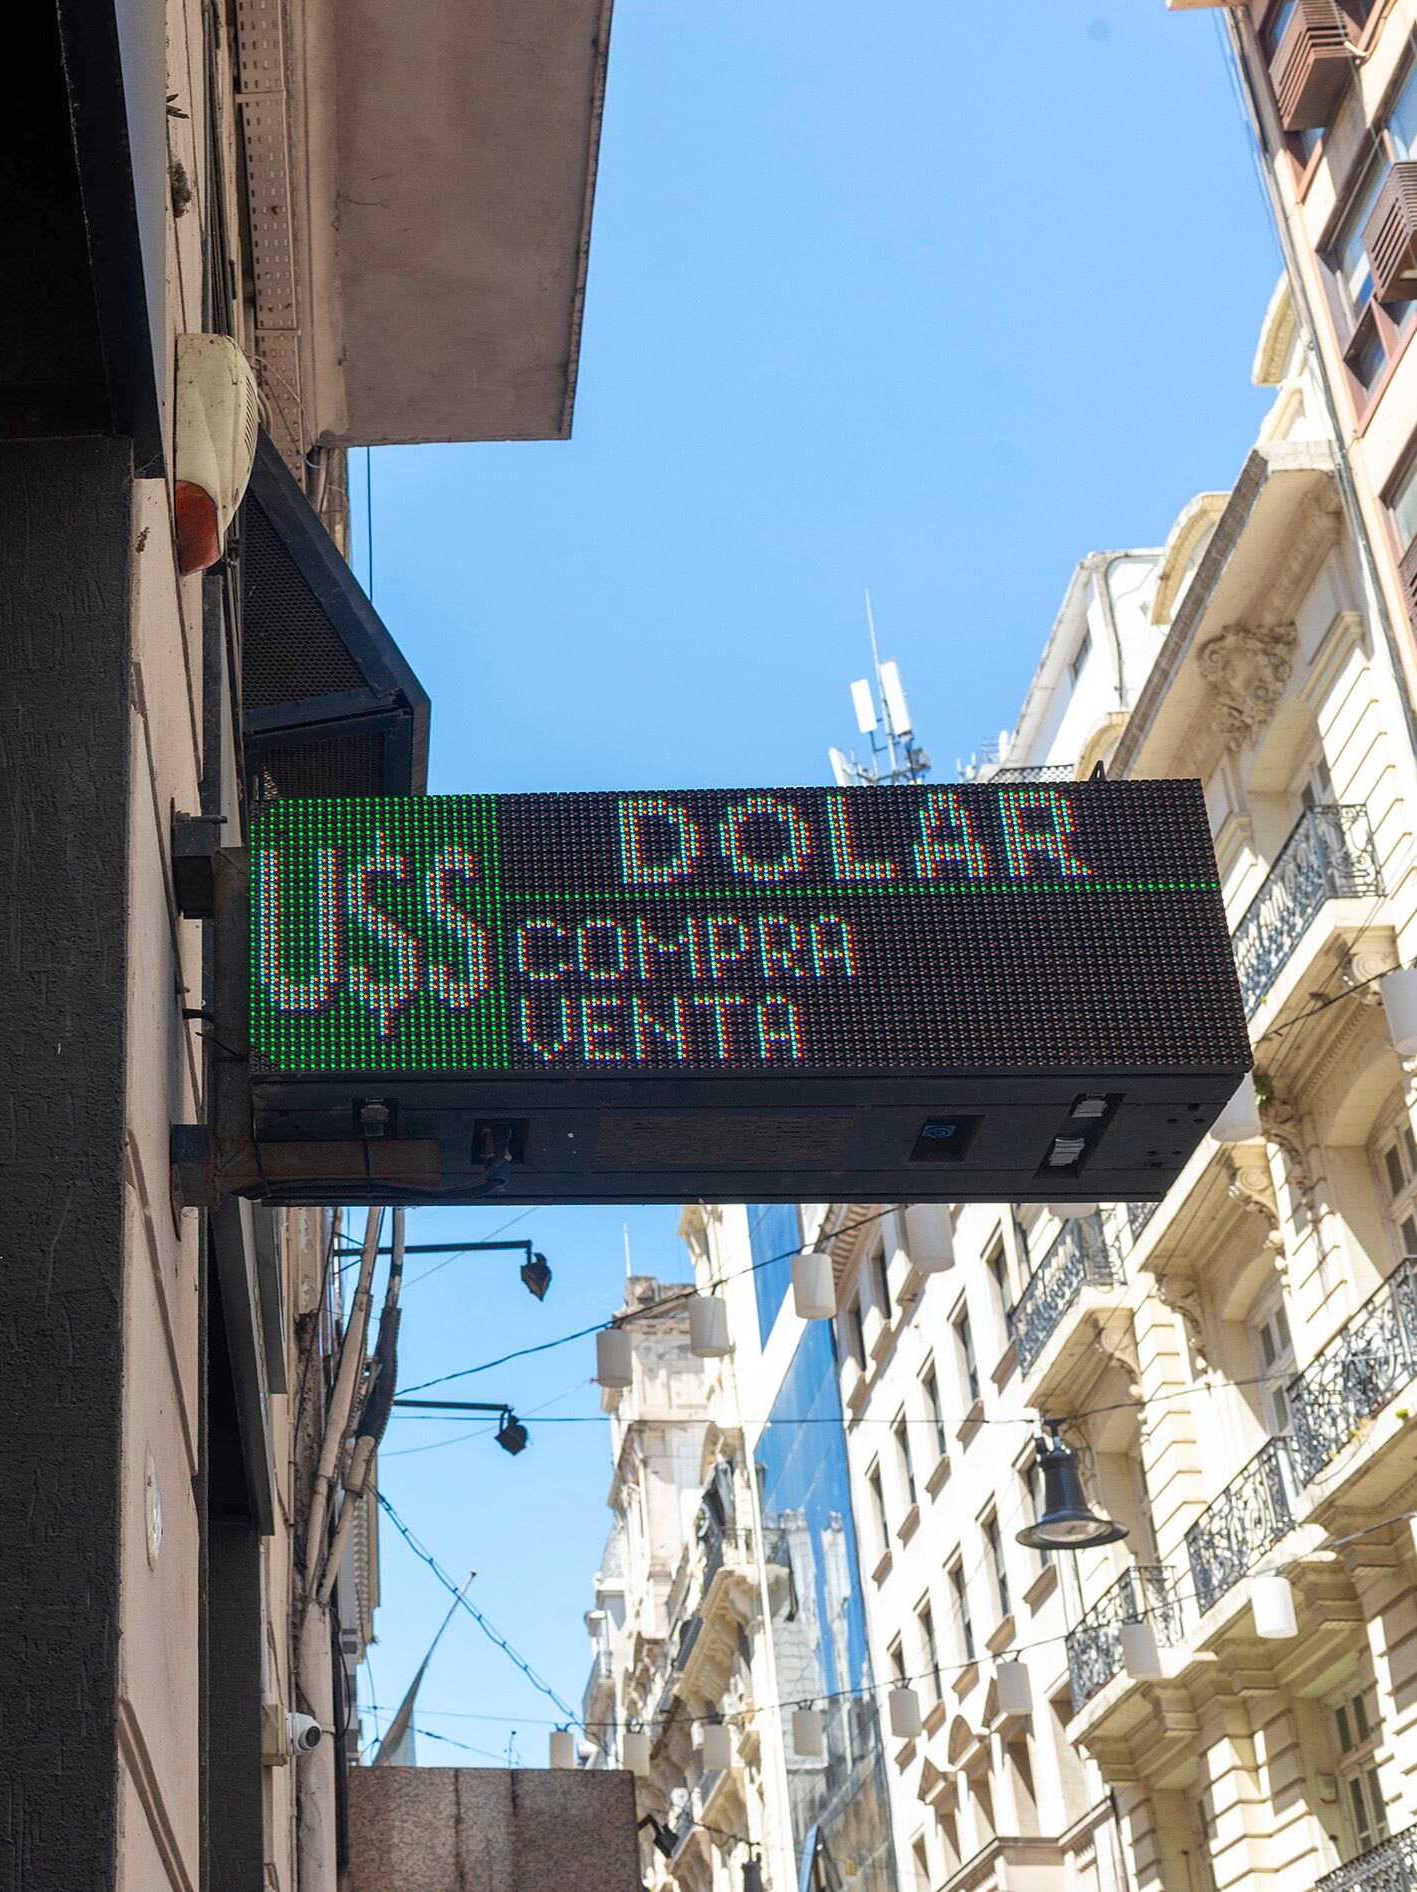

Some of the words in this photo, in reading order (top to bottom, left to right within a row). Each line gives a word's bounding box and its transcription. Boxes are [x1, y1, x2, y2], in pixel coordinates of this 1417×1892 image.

[618, 791, 1092, 884] DOLAR
[516, 914, 857, 981] COMPRA
[520, 995, 802, 1062] VENTA
